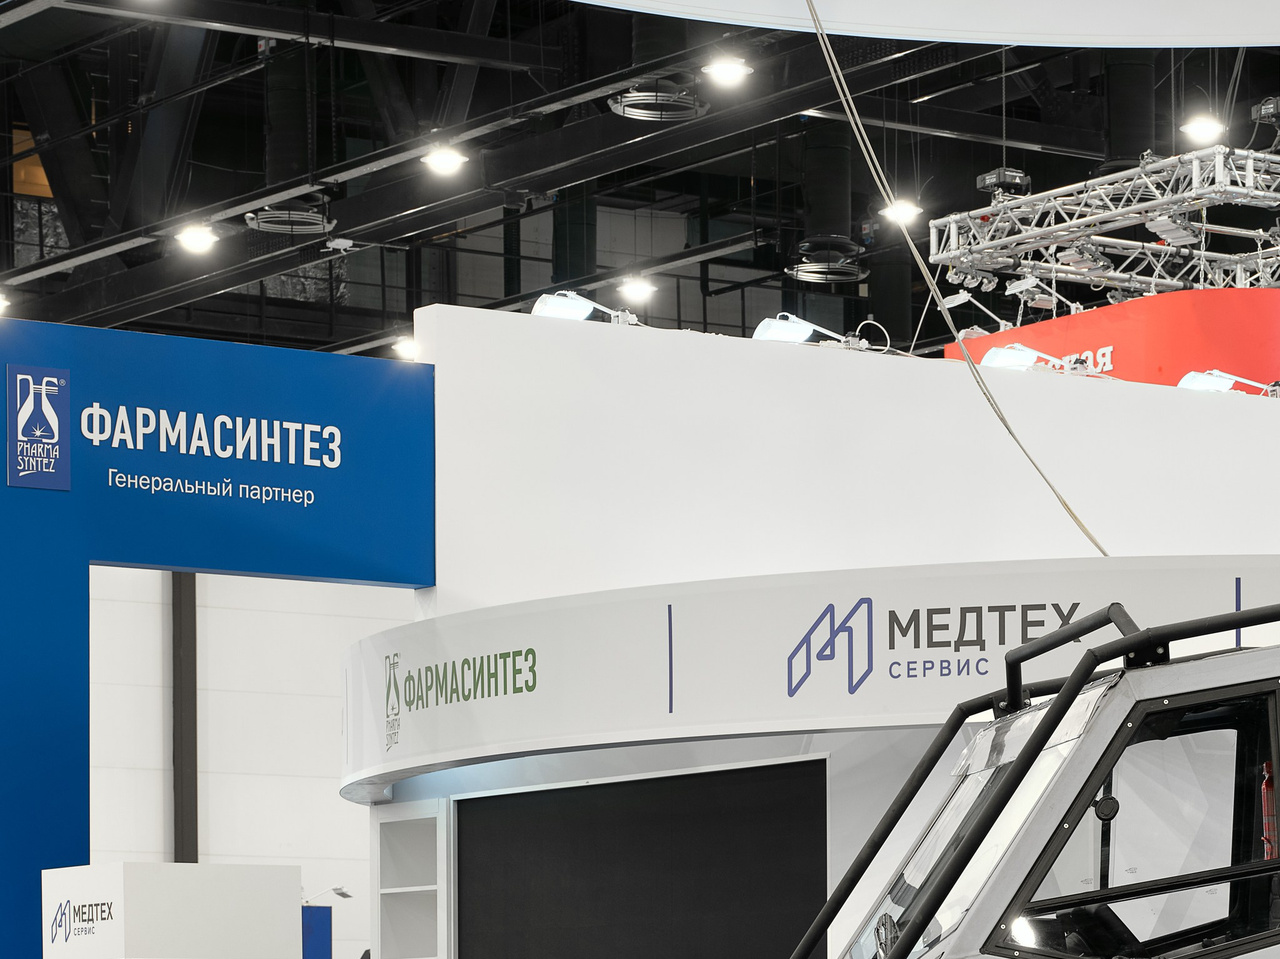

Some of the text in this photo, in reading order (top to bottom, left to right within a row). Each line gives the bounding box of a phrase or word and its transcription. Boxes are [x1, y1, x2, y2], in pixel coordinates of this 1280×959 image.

[80, 401, 342, 469] ФАРМАСИНТЕЗ
[17, 441, 60, 459] PHARMA
[16, 455, 56, 473] SYNTEZ
[108, 467, 315, 508] Генеральный партнер
[888, 602, 1082, 653] МЕДТЕХ
[888, 657, 990, 679] СЕРВИС
[403, 647, 538, 713] ФАРМАСИНТЕЗ
[73, 902, 114, 925] МЕДТЕХ
[73, 926, 96, 937] СЕРВИС
